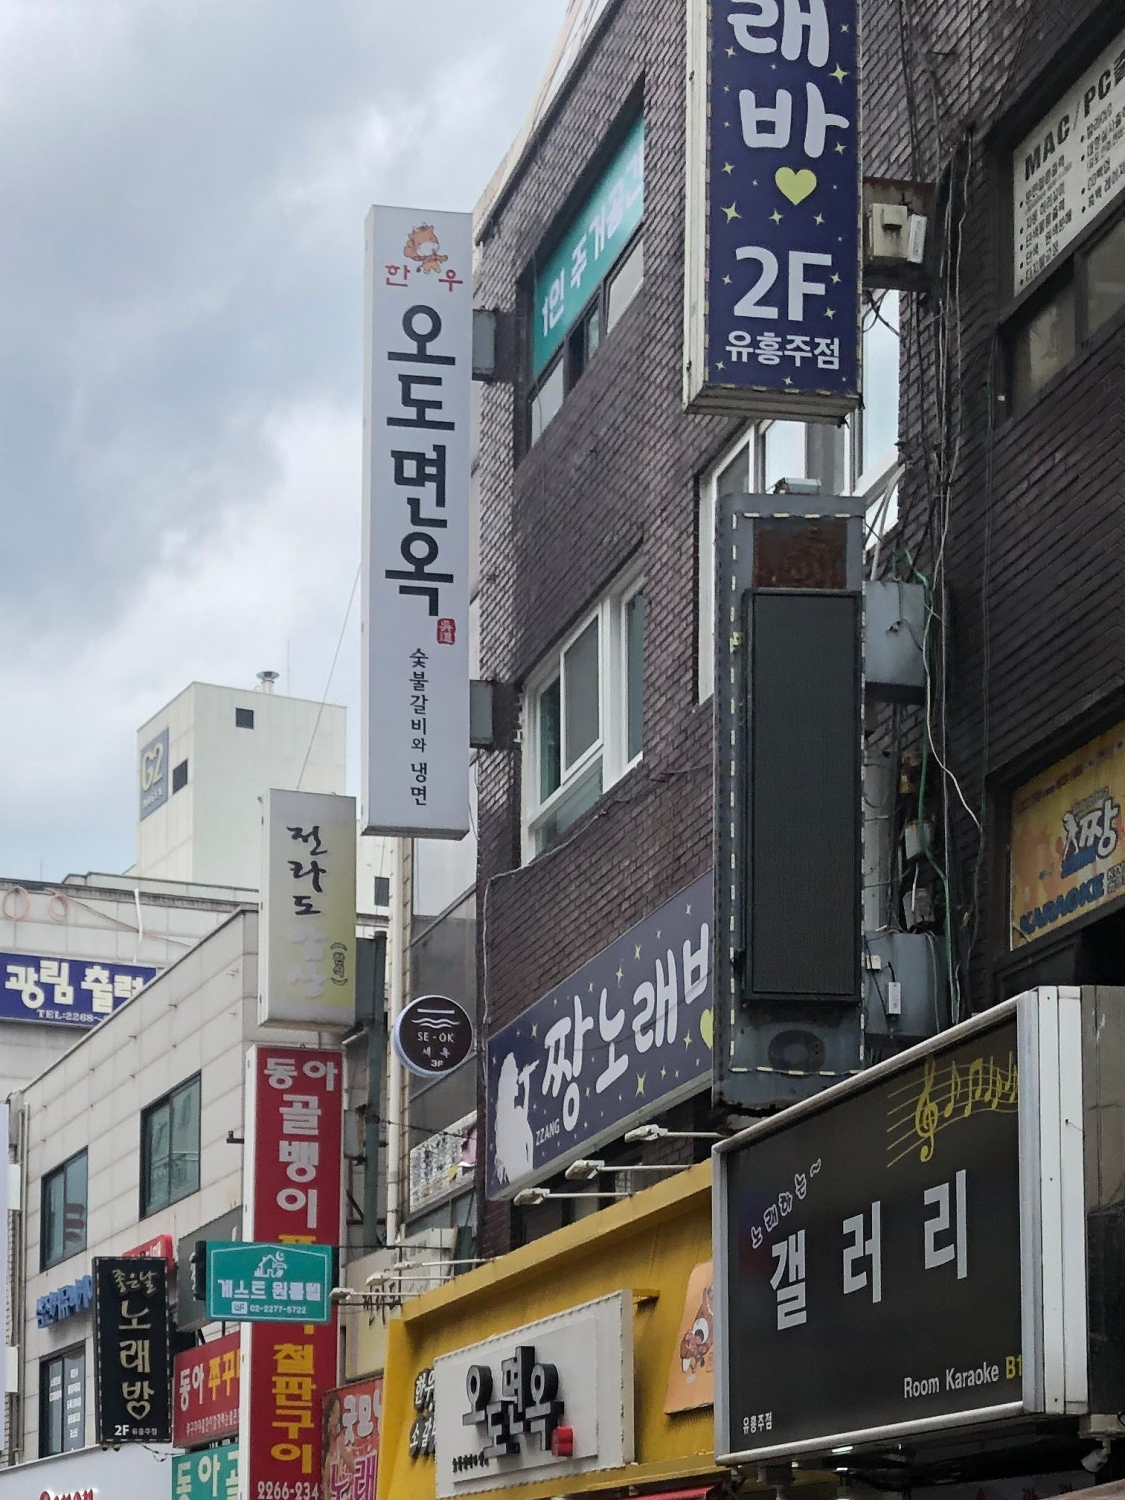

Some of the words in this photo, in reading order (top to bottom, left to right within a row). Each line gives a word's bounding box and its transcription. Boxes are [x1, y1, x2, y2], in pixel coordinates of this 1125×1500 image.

[1025, 115, 1070, 181] MAC
[733, 246, 832, 321] 2F
[725, 330, 840, 370] 유흥주점
[385, 304, 456, 616] 오도면옥
[409, 763, 429, 805] 냉면
[286, 826, 328, 916] 전라도
[5, 960, 74, 1009] 광림
[264, 1058, 338, 1092] 동아
[535, 1117, 560, 1147] ZZANG
[276, 1094, 322, 1229] 골뱅이
[770, 1169, 968, 1331] 갤러리
[179, 1363, 204, 1412] 동아
[208, 1347, 240, 1401] 쭈꾸
[904, 1376, 940, 1399] Room
[945, 1363, 1000, 1389] Karaoke
[1005, 1356, 1023, 1379] B1
[114, 1424, 130, 1436] 2F
[270, 1343, 317, 1475] 철판구이
[257, 1481, 323, 1500] 2266-234
